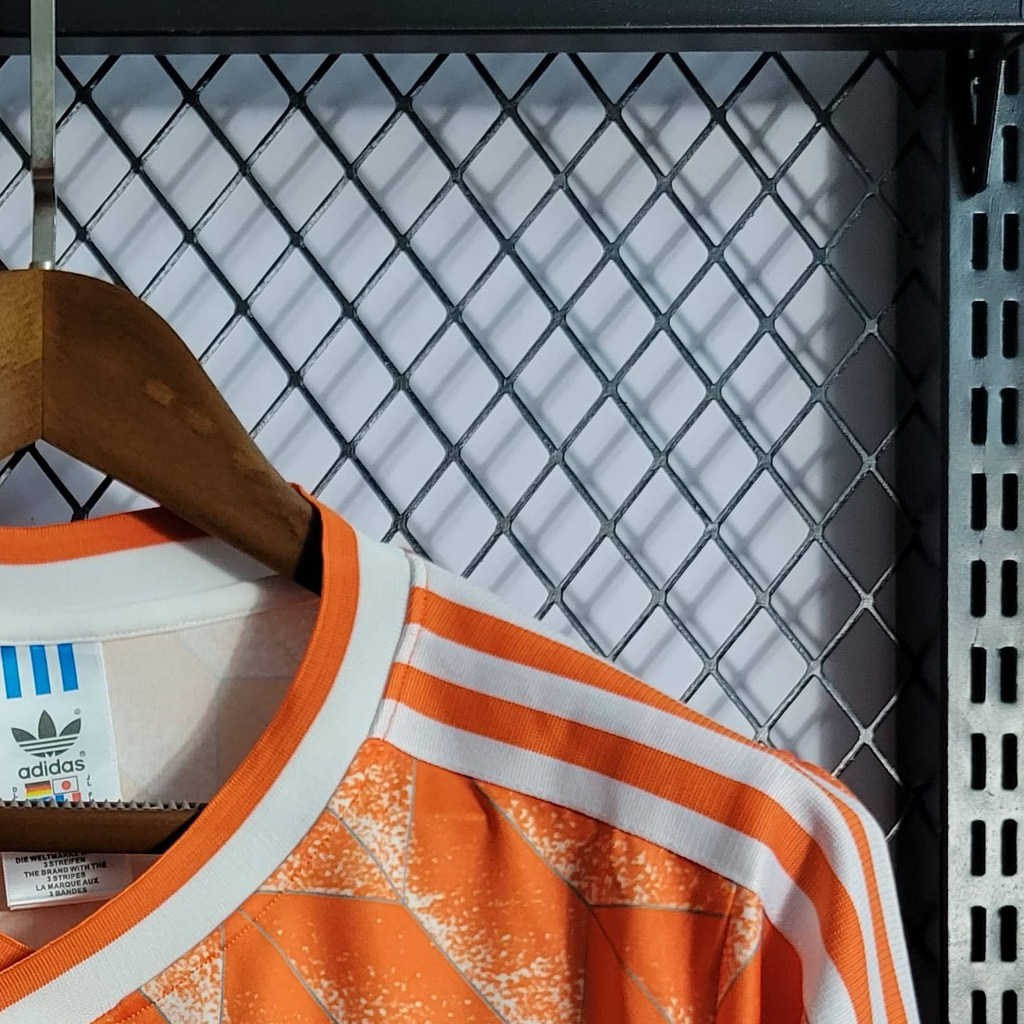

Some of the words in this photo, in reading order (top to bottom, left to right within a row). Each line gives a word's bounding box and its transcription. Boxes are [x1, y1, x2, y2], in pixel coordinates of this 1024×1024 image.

[18, 758, 86, 780] adidas
[15, 856, 29, 865] DIE
[49, 857, 86, 868] STREIFEN
[24, 869, 40, 878] THE
[41, 866, 69, 876] BRAND
[70, 863, 90, 873] WITH
[91, 860, 107, 869] THE
[53, 871, 86, 881] STRIPES
[35, 883, 47, 891] LA
[47, 879, 81, 890] MARQUE
[82, 877, 99, 886] AUX
[56, 886, 87, 897] BANDES
